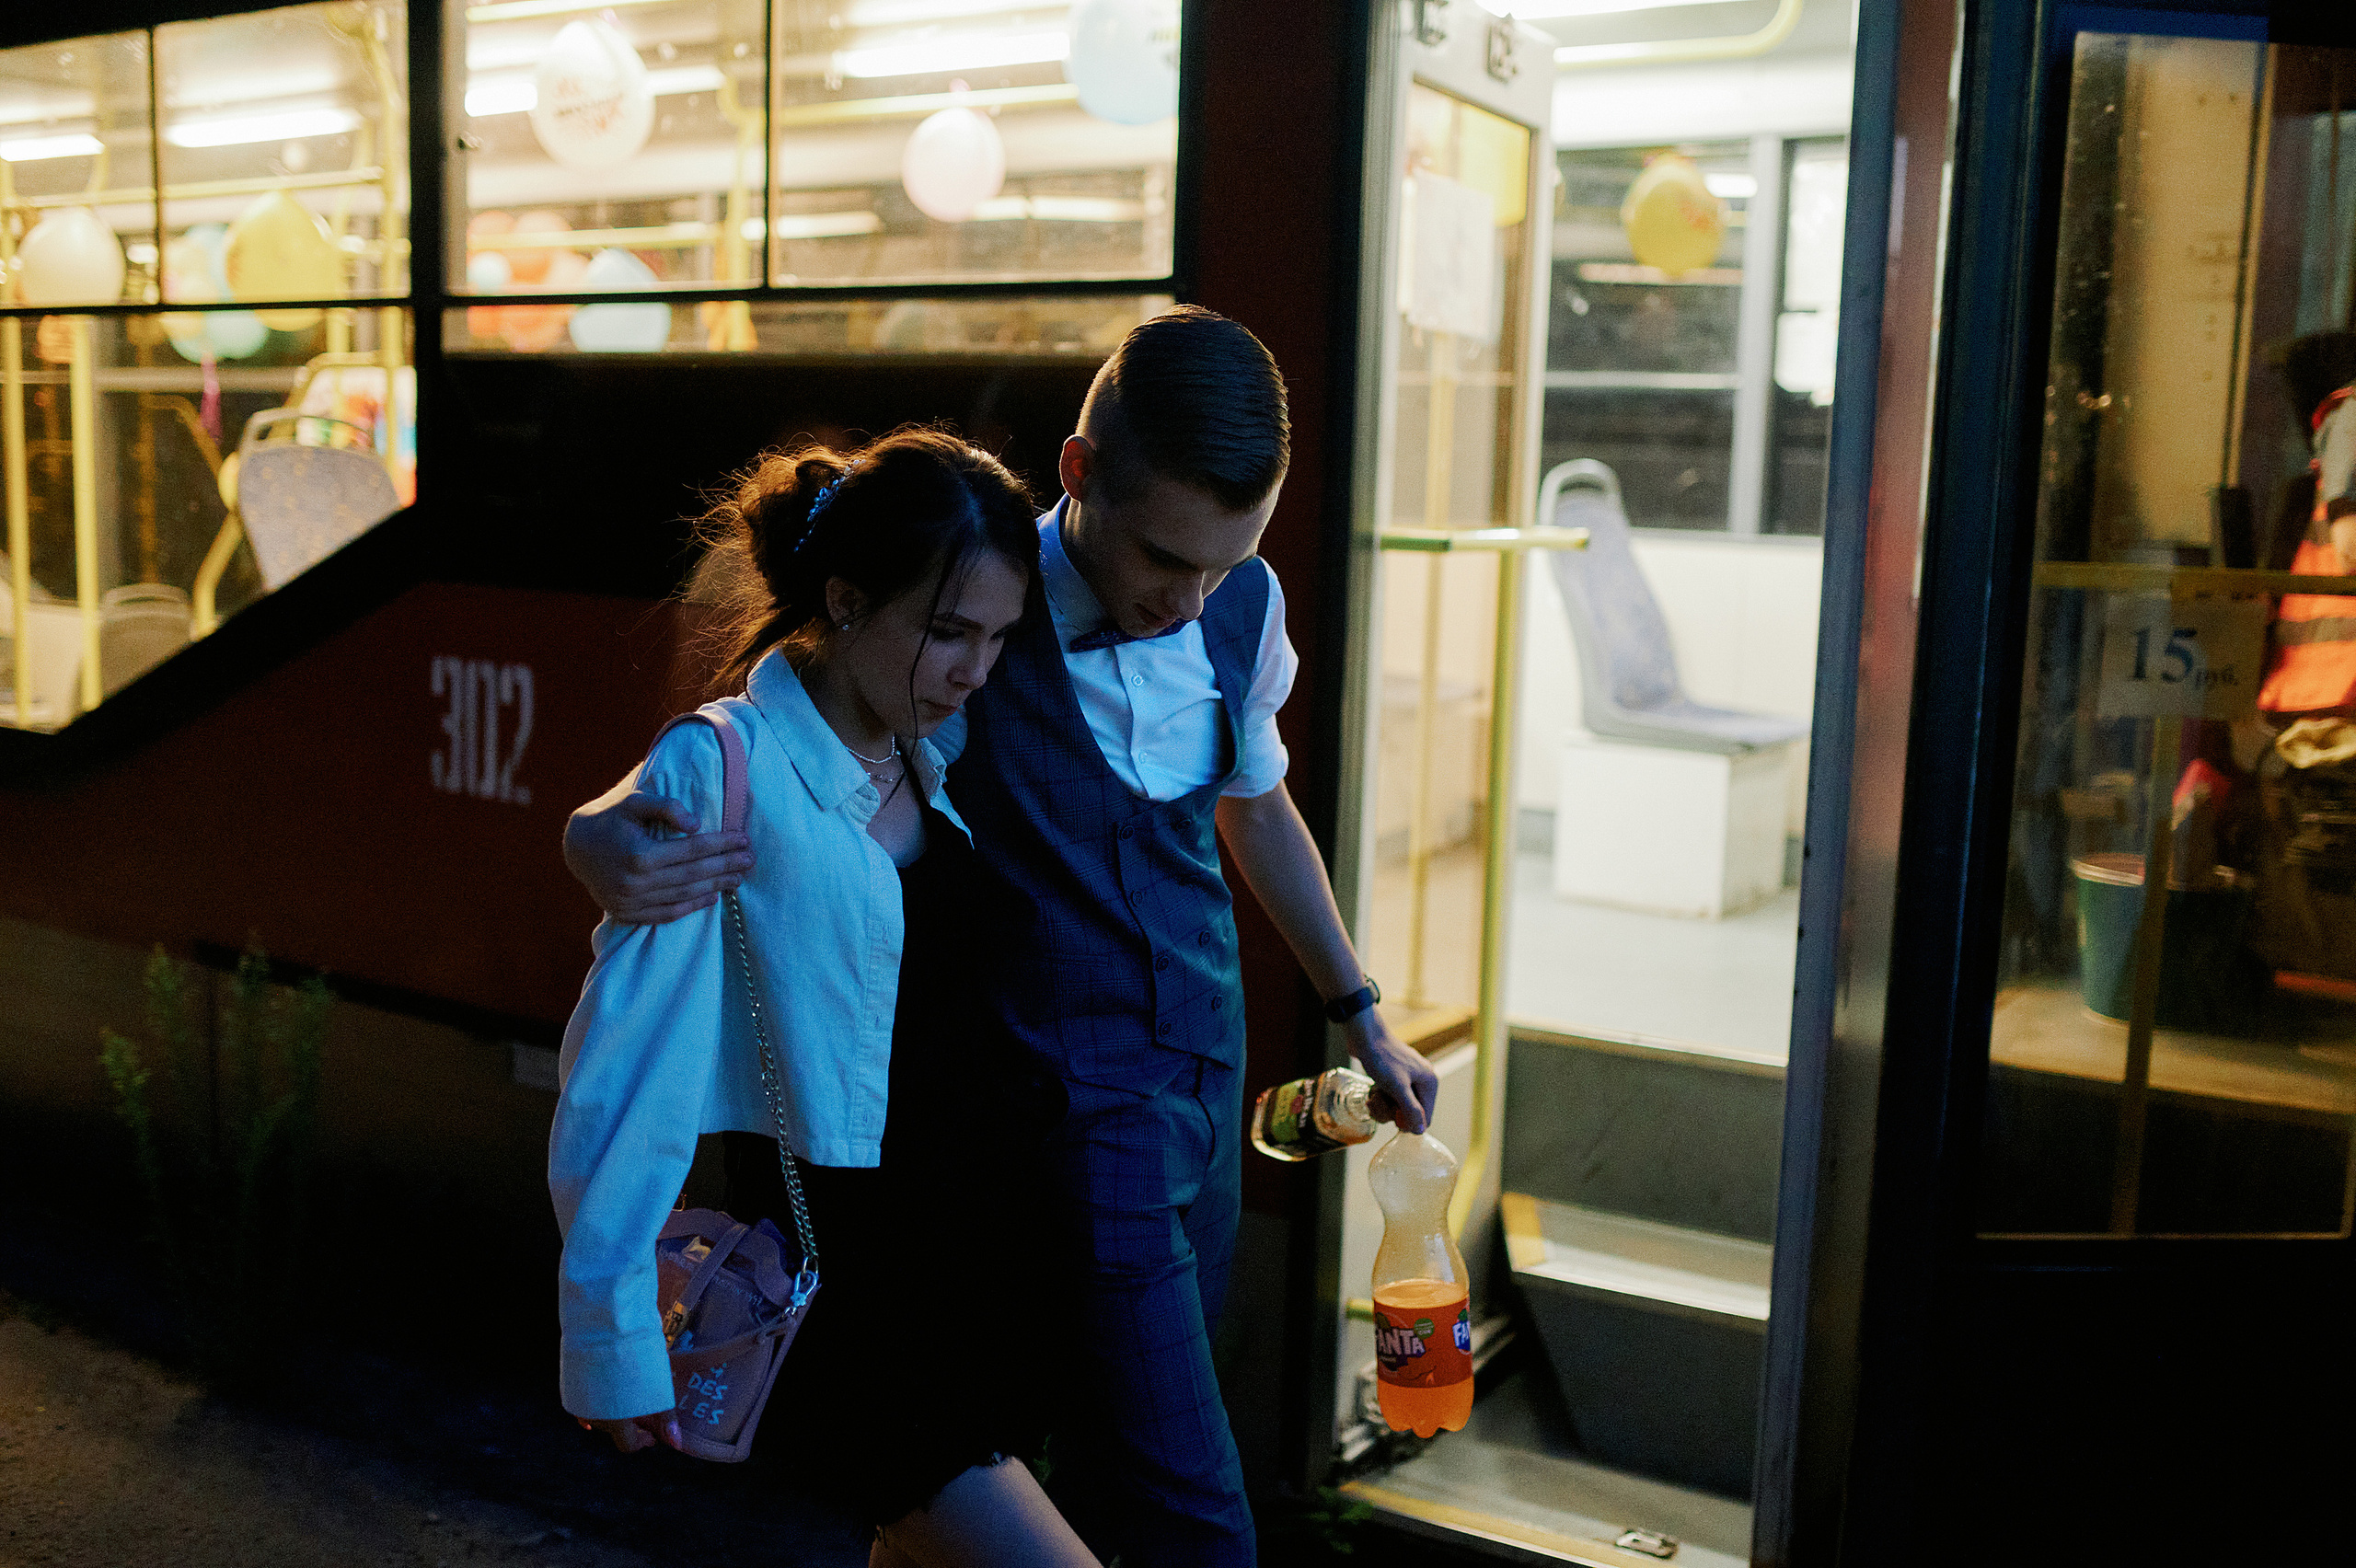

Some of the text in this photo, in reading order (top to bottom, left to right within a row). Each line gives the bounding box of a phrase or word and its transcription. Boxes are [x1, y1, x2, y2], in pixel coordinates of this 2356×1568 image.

[2128, 627, 2199, 684] 15
[431, 655, 533, 806] 302
[1377, 1327, 1426, 1355] ANTA
[687, 1371, 729, 1401] DES
